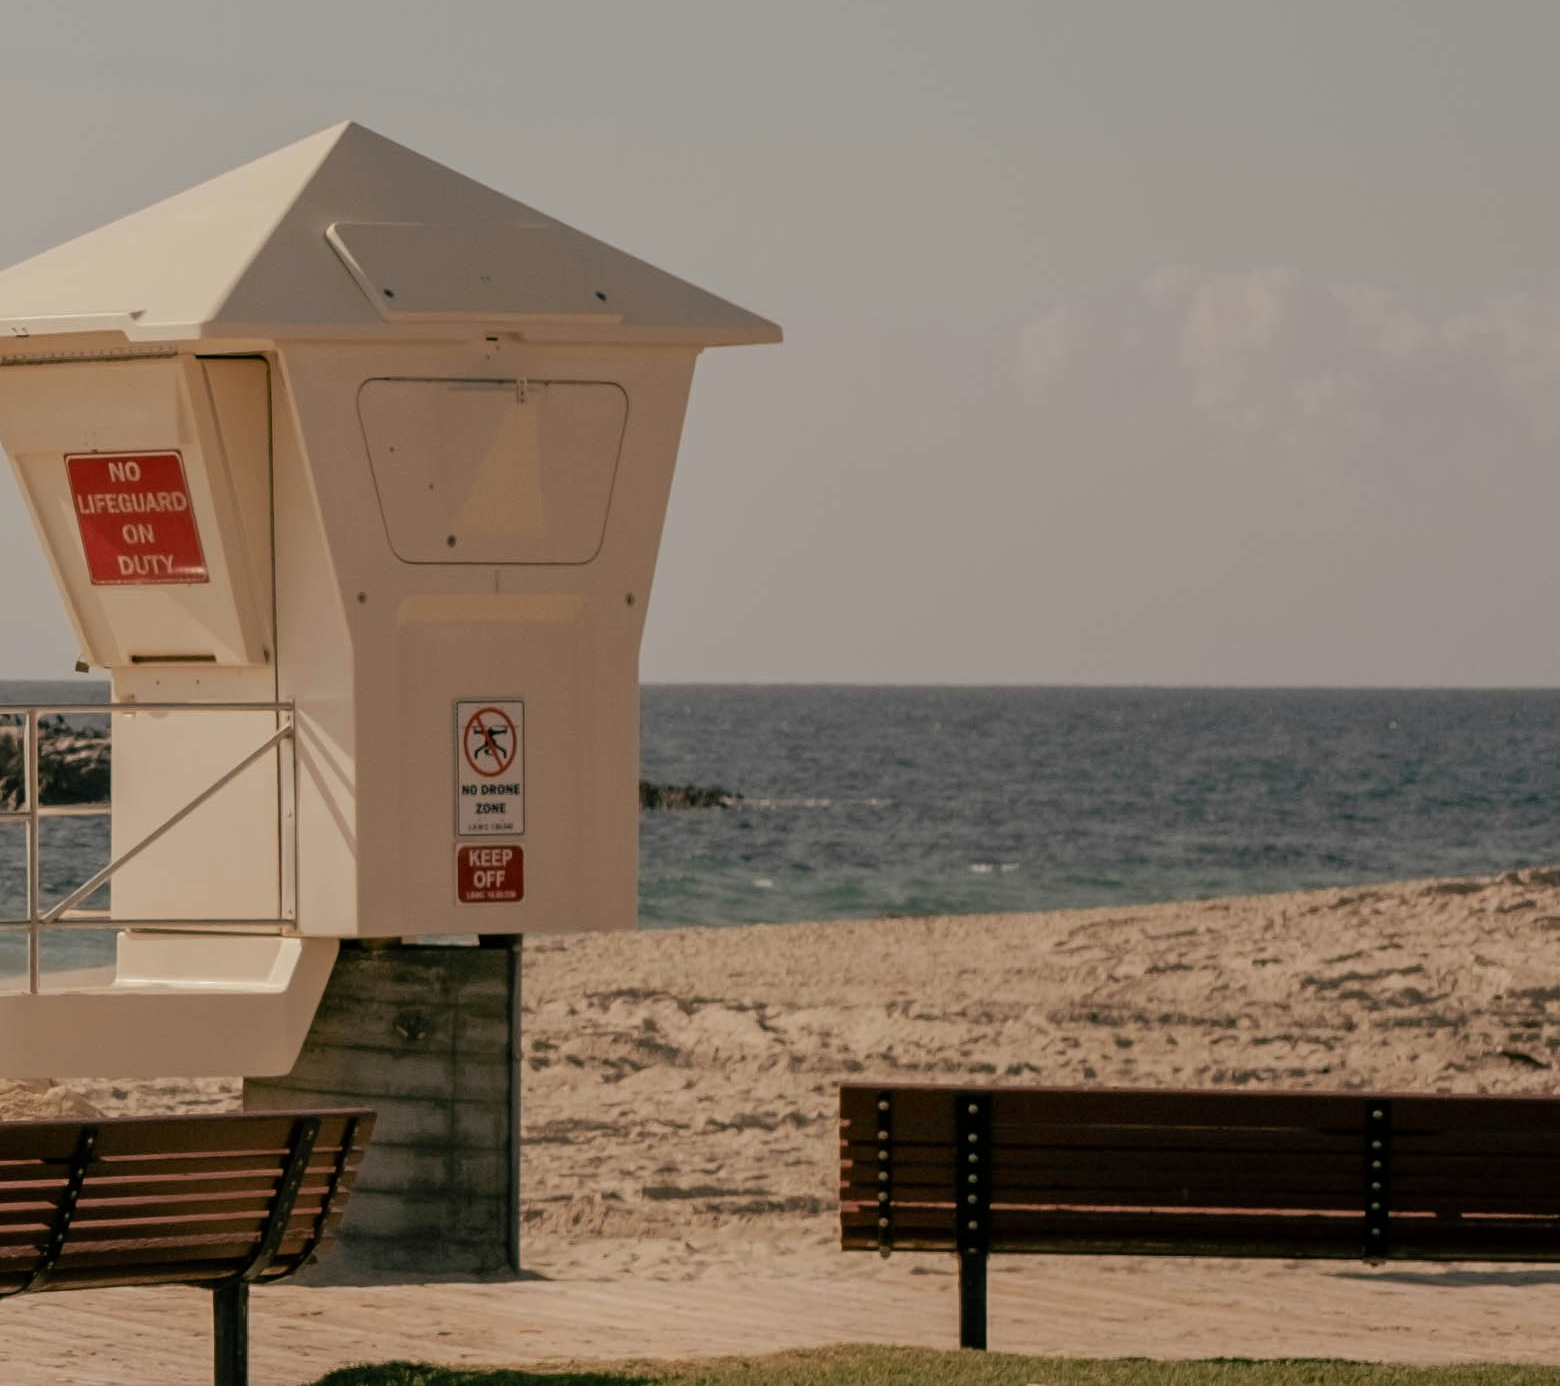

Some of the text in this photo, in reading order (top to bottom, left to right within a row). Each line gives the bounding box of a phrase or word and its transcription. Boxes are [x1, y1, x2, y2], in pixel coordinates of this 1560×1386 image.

[108, 461, 141, 483] NO
[77, 491, 188, 515] LIFEGUARD
[122, 523, 156, 545] ON
[118, 555, 174, 576] DUTY
[461, 783, 521, 796] NO DRONE
[475, 803, 507, 814] ZONE
[469, 849, 513, 867] KEEP
[473, 870, 507, 889] OFF
